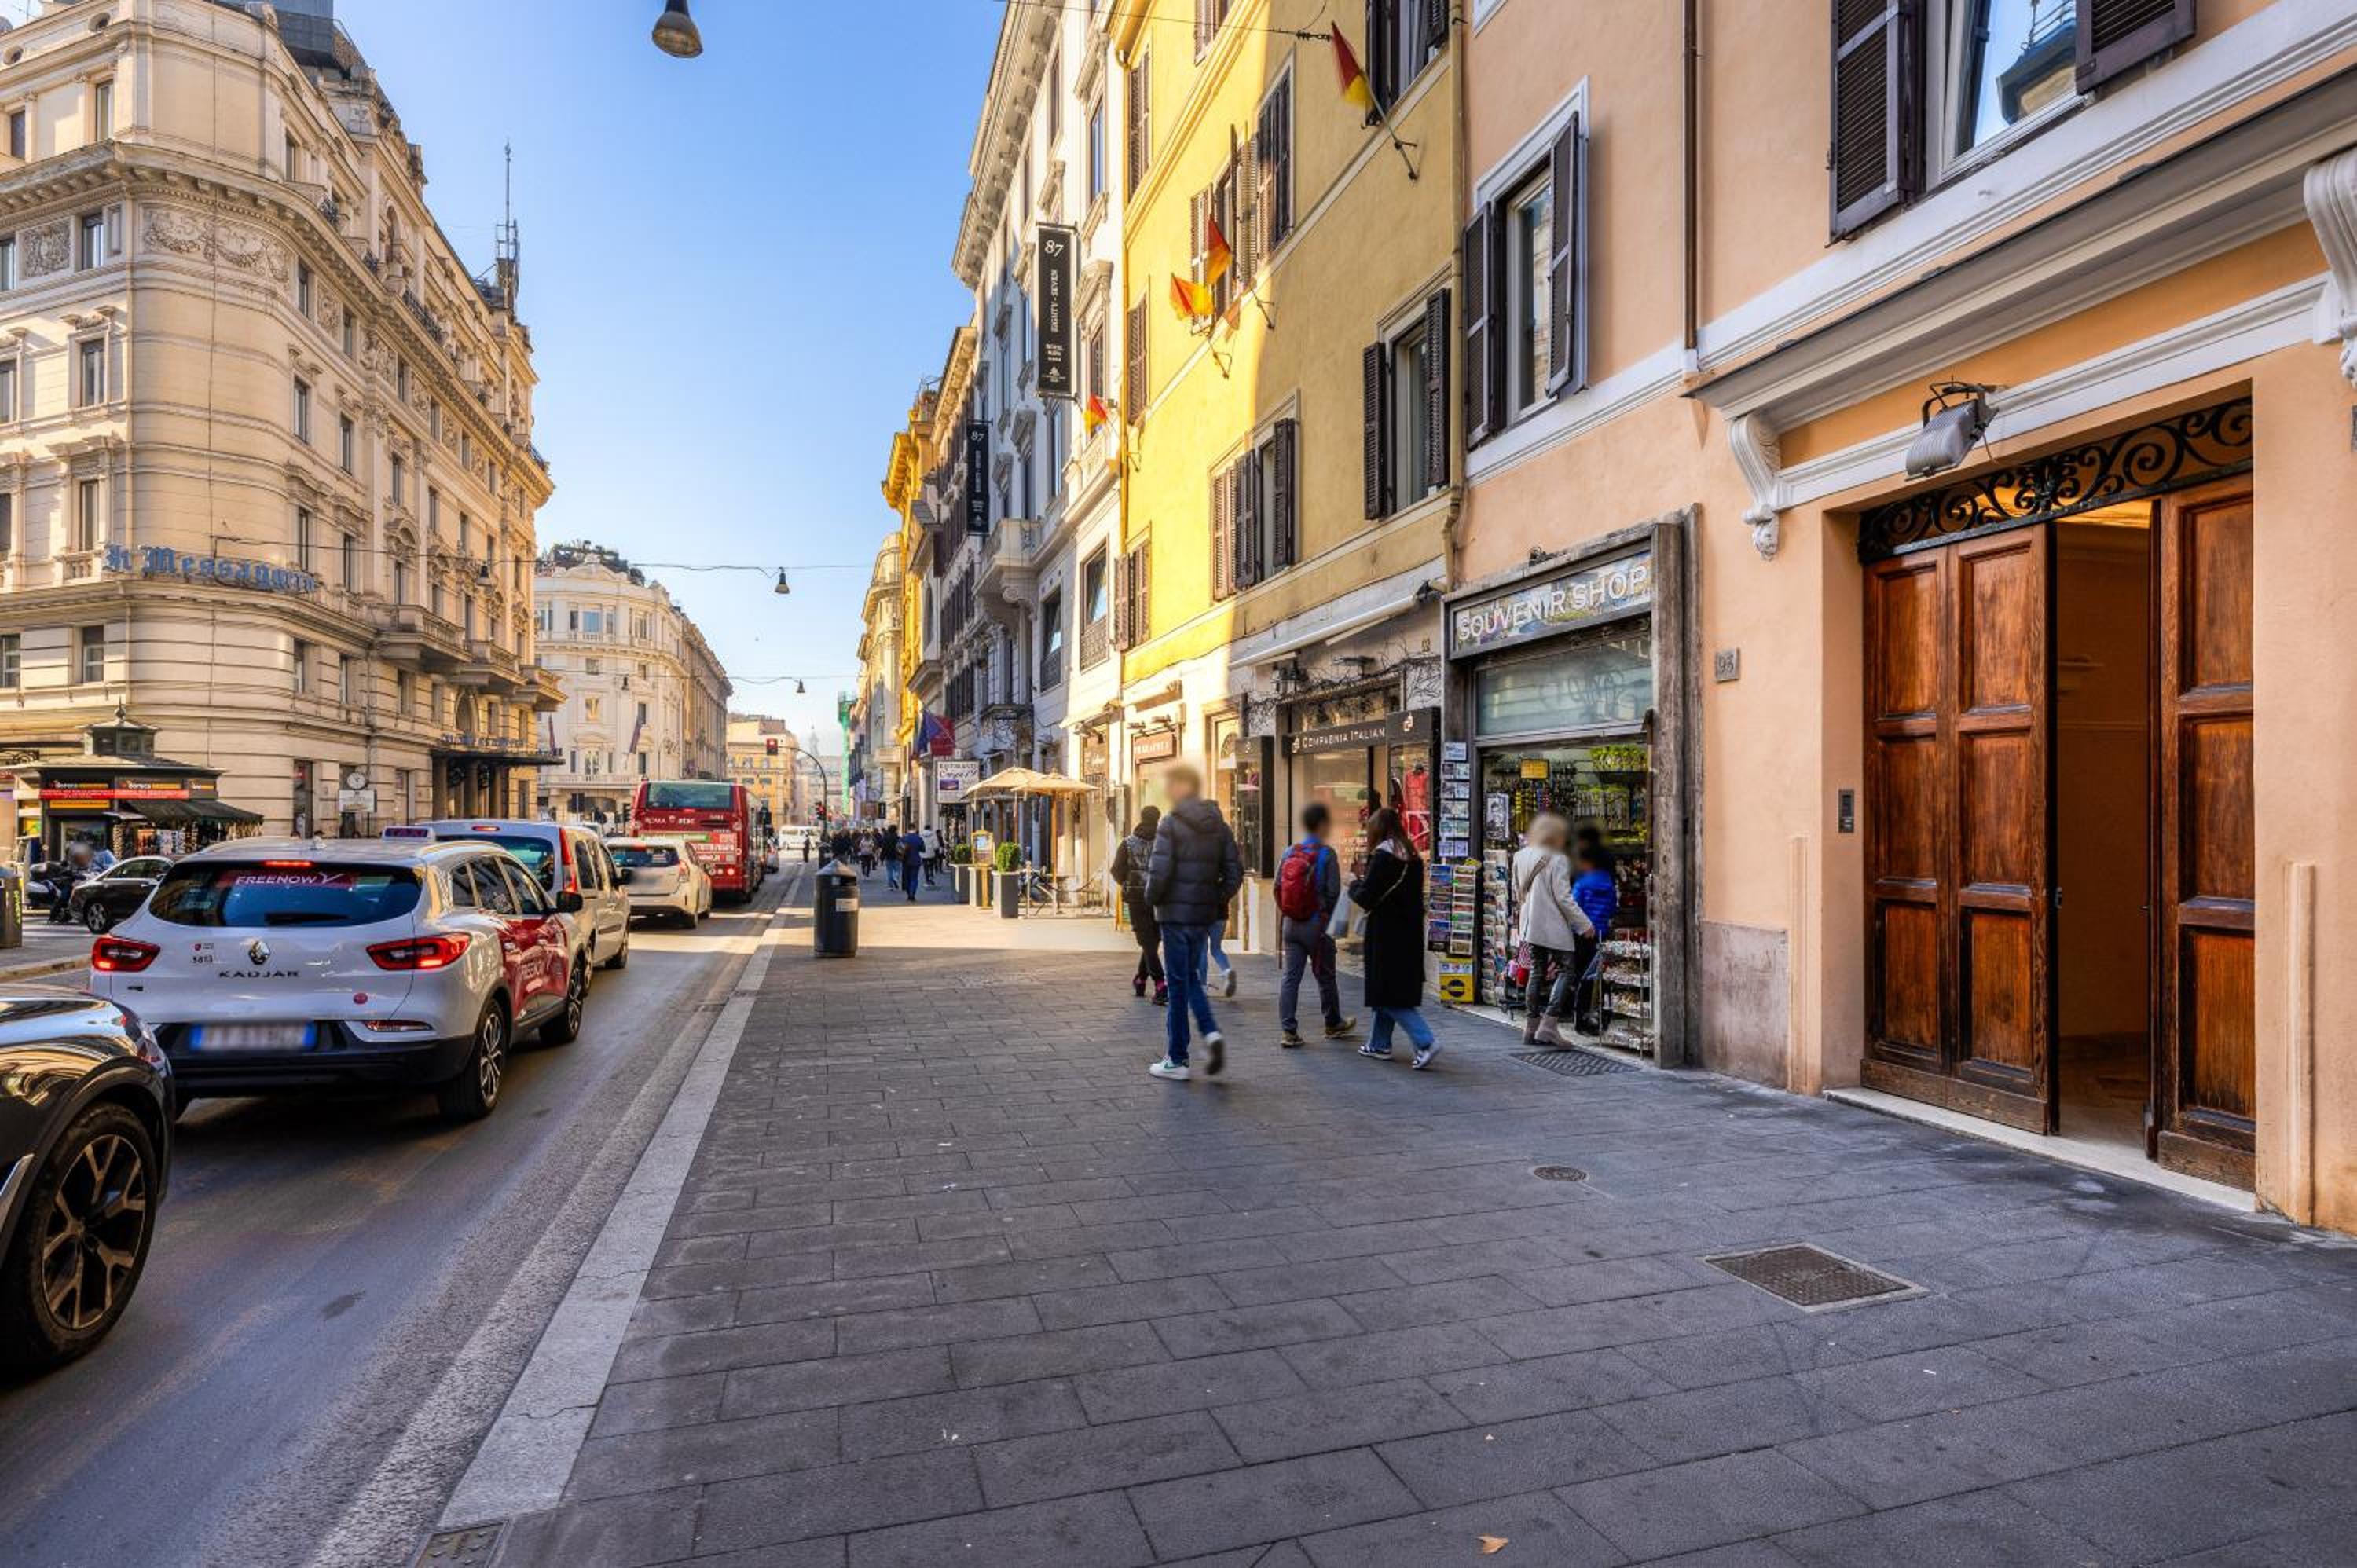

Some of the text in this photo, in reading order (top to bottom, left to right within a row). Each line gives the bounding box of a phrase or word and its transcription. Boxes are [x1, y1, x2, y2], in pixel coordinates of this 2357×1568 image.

[1044, 239, 1064, 258] 87
[970, 430, 984, 441] 87
[1457, 565, 1648, 641] SOUVENIR SHOP
[236, 875, 316, 885] FREENOW
